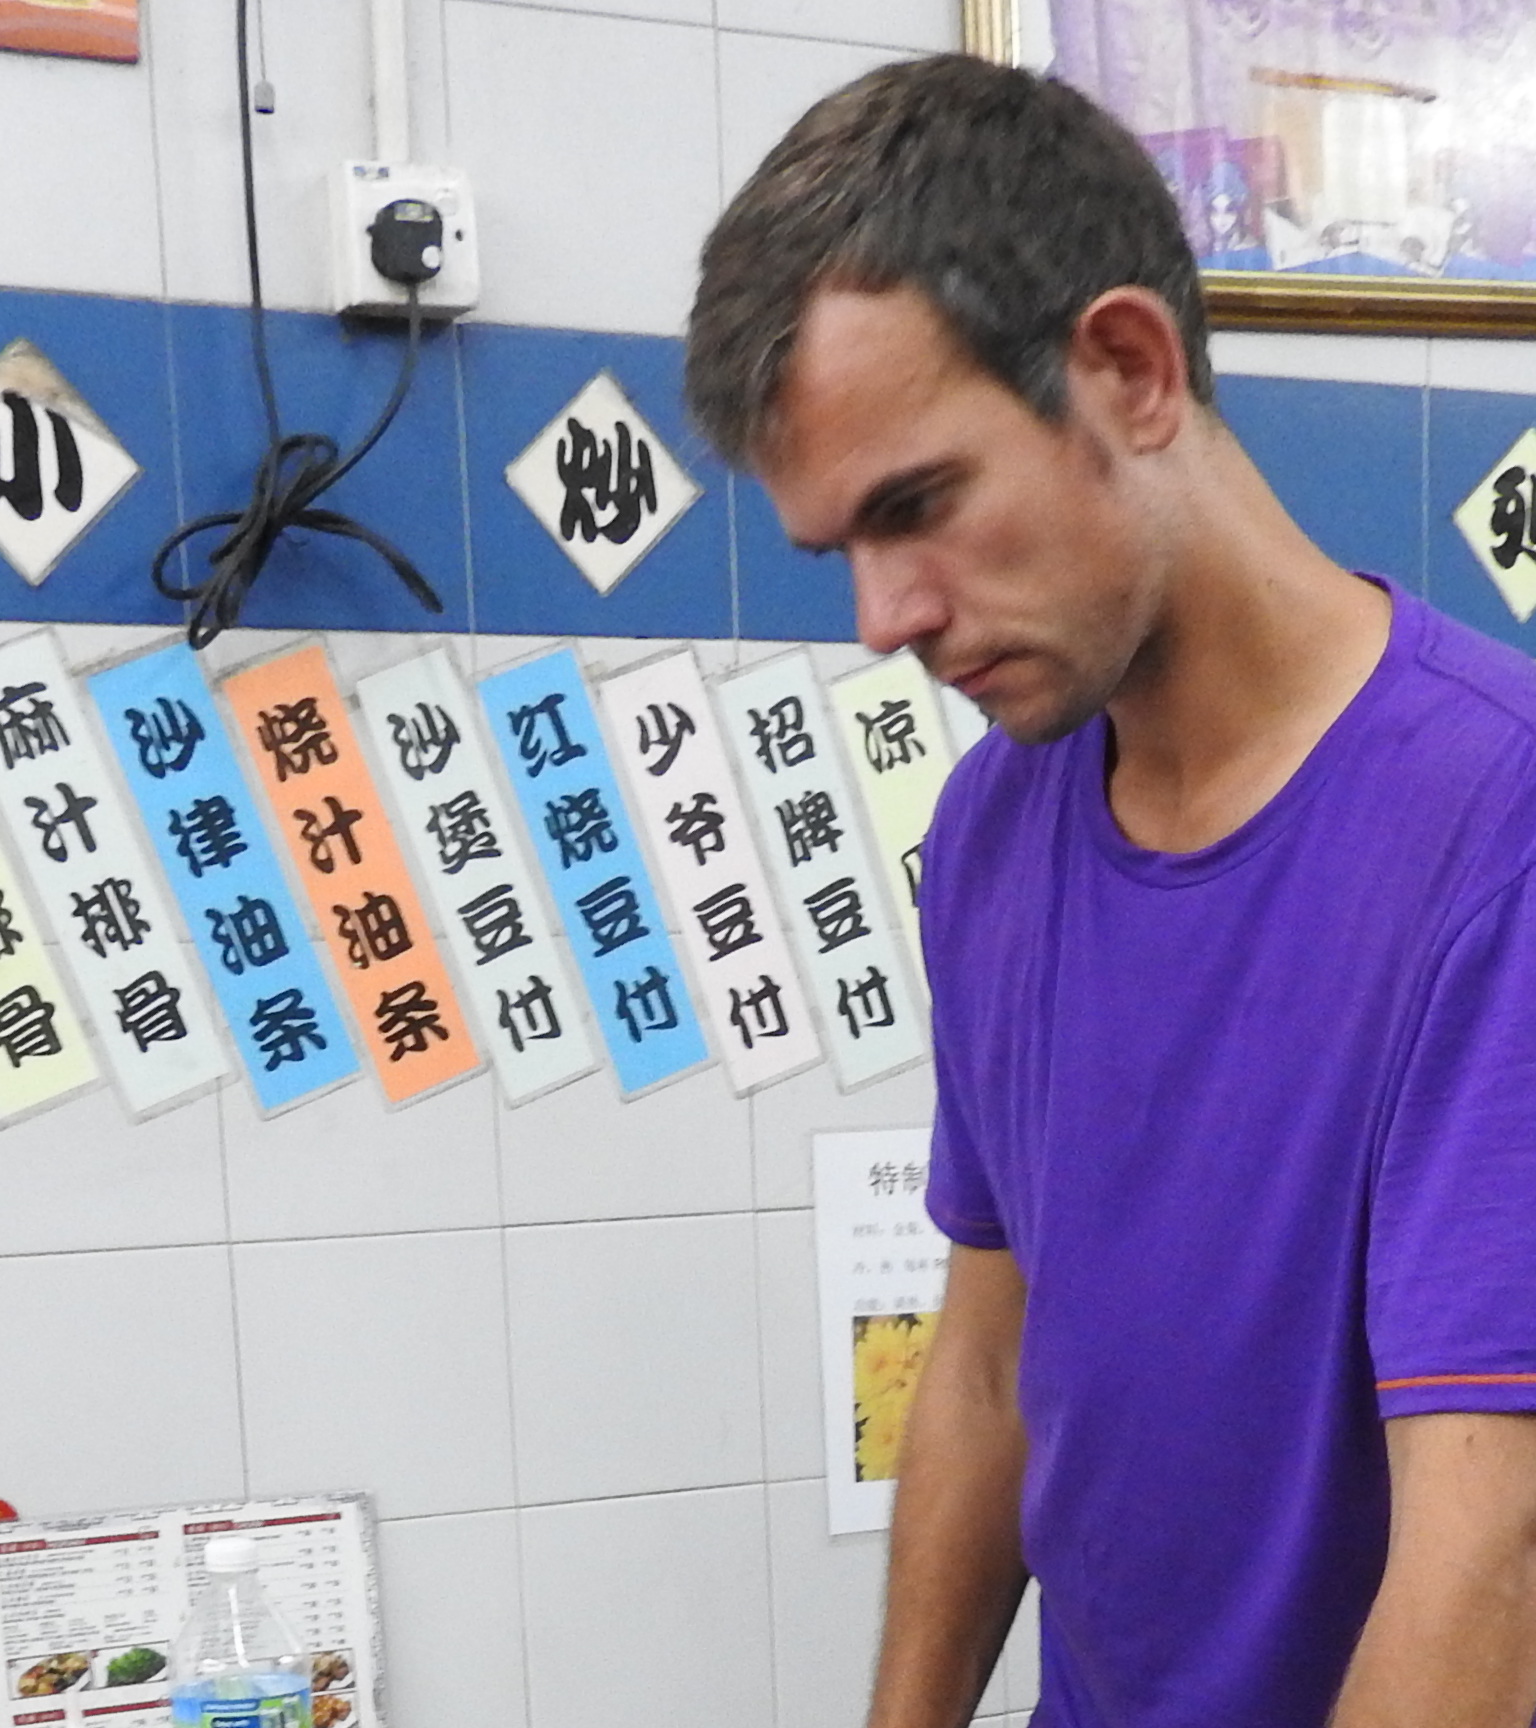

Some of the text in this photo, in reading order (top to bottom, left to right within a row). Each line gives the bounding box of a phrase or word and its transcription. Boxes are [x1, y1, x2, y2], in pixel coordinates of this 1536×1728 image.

[124, 696, 329, 1072] 沙律油条
[256, 695, 450, 1061] 烧汁油条
[391, 702, 565, 1053] 沙煲豆付
[507, 692, 680, 1044] 红烧豆付
[638, 703, 792, 1049] 少爷豆付
[749, 694, 896, 1040] 招牌豆付
